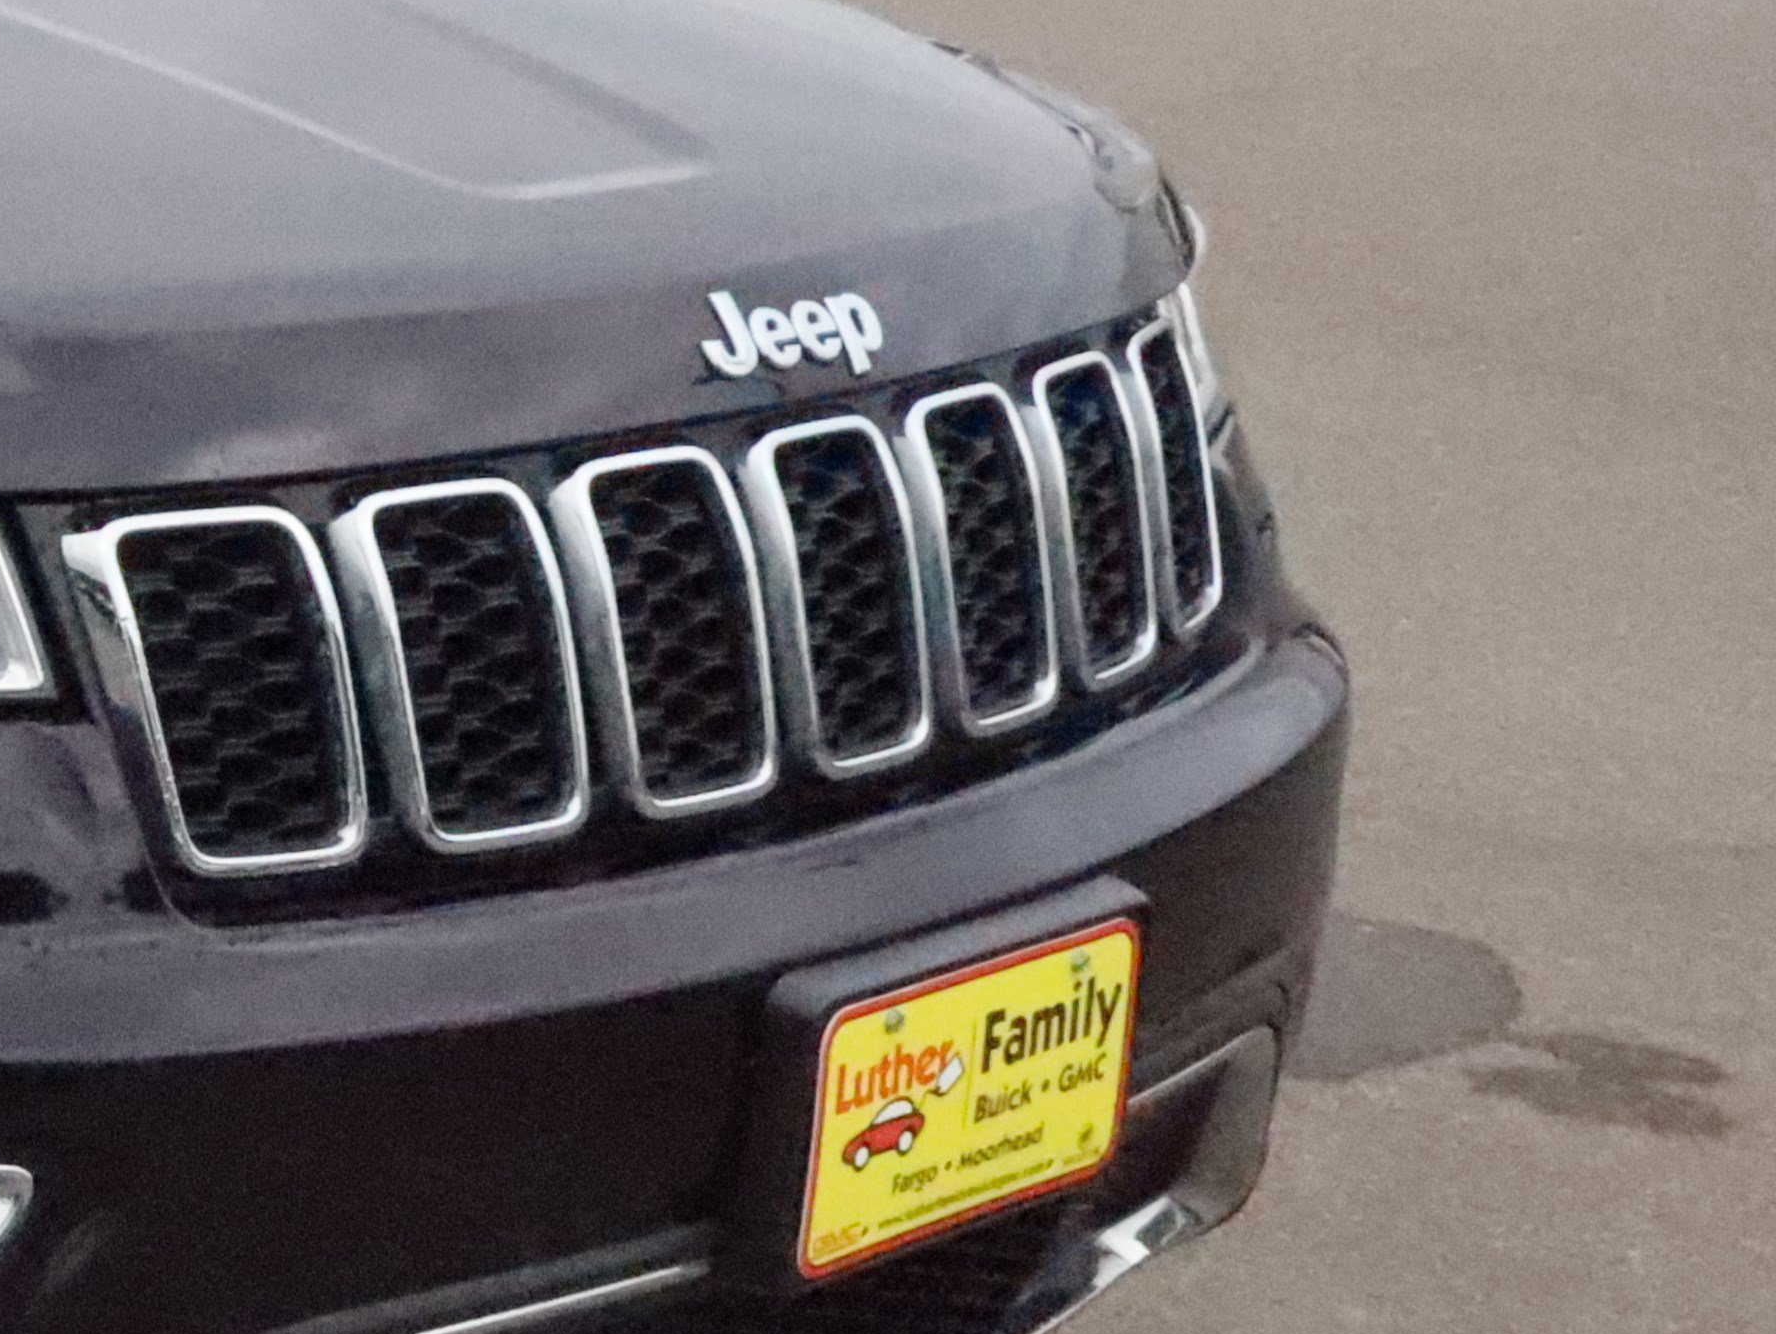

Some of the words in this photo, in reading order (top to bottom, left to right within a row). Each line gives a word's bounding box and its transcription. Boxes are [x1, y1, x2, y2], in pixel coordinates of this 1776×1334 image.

[701, 290, 883, 376] Jeep
[982, 976, 1122, 1073] Family
[836, 1039, 954, 1115] Luther
[973, 1079, 1034, 1124] Buick
[1058, 1053, 1107, 1092] GMC
